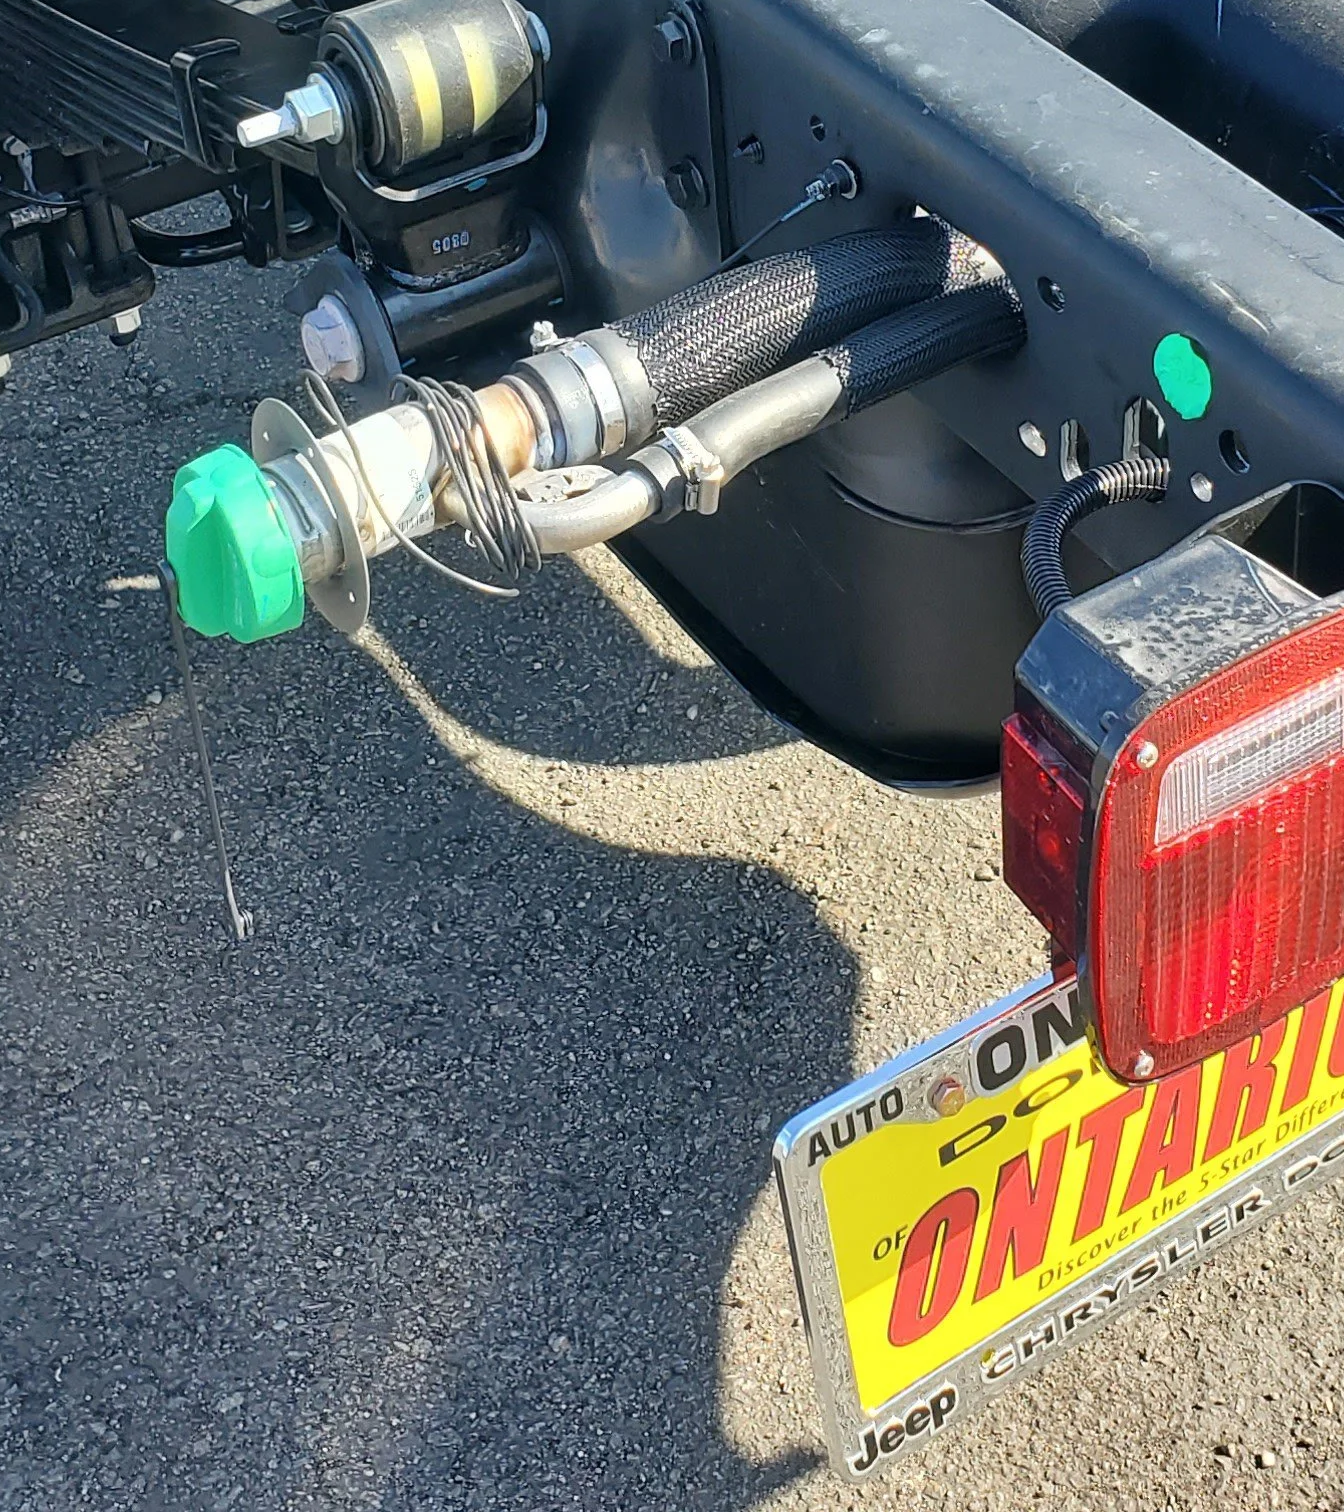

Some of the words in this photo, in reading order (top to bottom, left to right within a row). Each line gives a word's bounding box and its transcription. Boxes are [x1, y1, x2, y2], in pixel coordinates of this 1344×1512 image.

[807, 1086, 904, 1168] AUTO
[873, 1224, 909, 1262] OF
[1037, 1216, 1142, 1292] Discover
[1151, 1189, 1187, 1222] the
[1199, 1138, 1267, 1190] 5-Star
[850, 1384, 958, 1474] Jeep
[983, 1187, 1271, 1381] CHRYSLER
